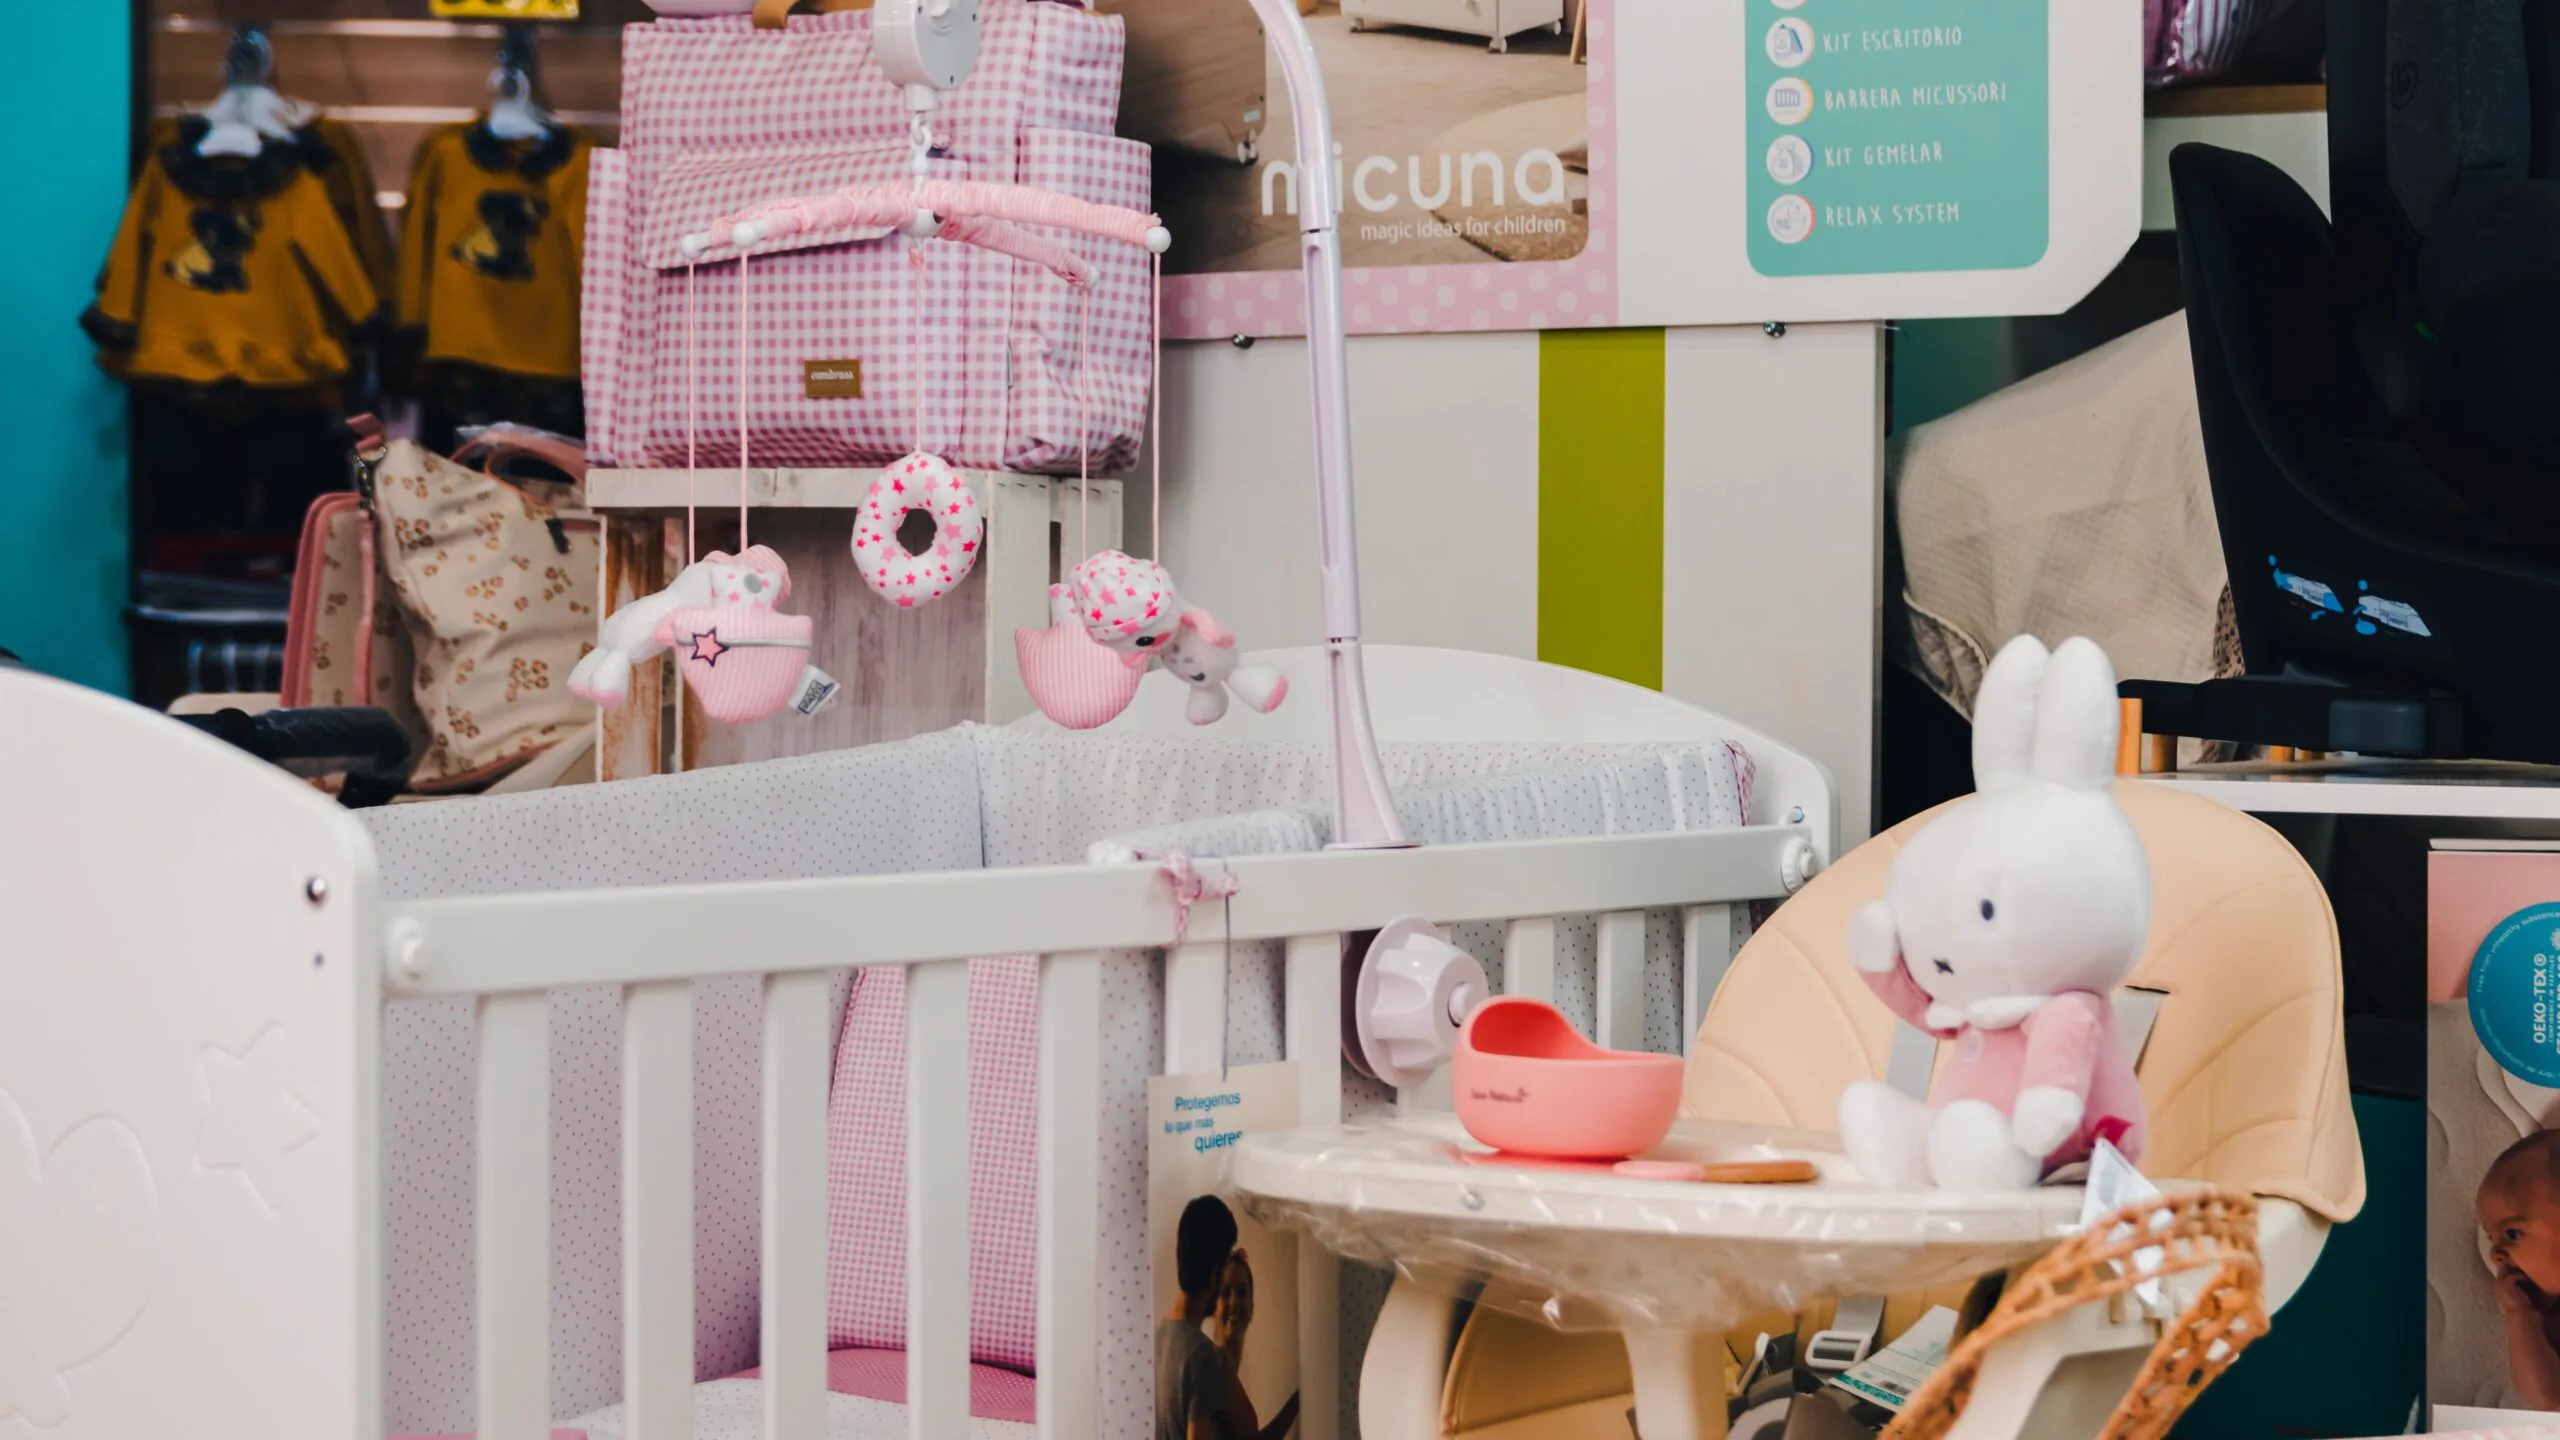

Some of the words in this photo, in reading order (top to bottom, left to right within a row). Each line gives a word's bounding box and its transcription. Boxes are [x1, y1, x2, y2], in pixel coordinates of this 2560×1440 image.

[1822, 33, 1851, 53] KIT
[1862, 26, 1962, 51] ESCRITORIO
[1825, 88, 1902, 111] BARRERA
[1912, 81, 2006, 106] MICUSSORI
[1825, 146, 1853, 167] KIT
[1864, 141, 1943, 166] GEMELAR
[1261, 142, 1565, 216] micuna
[1826, 205, 1883, 226] RELAX
[1892, 202, 1960, 224] SYSTEM
[1361, 221, 1413, 244] magic
[1418, 217, 1461, 238] ideas
[1465, 216, 1490, 236] for
[1494, 214, 1566, 235] children
[1175, 1092, 1241, 1112] Protegemos
[1165, 1121, 1173, 1133] lo
[1176, 1120, 1192, 1134] que
